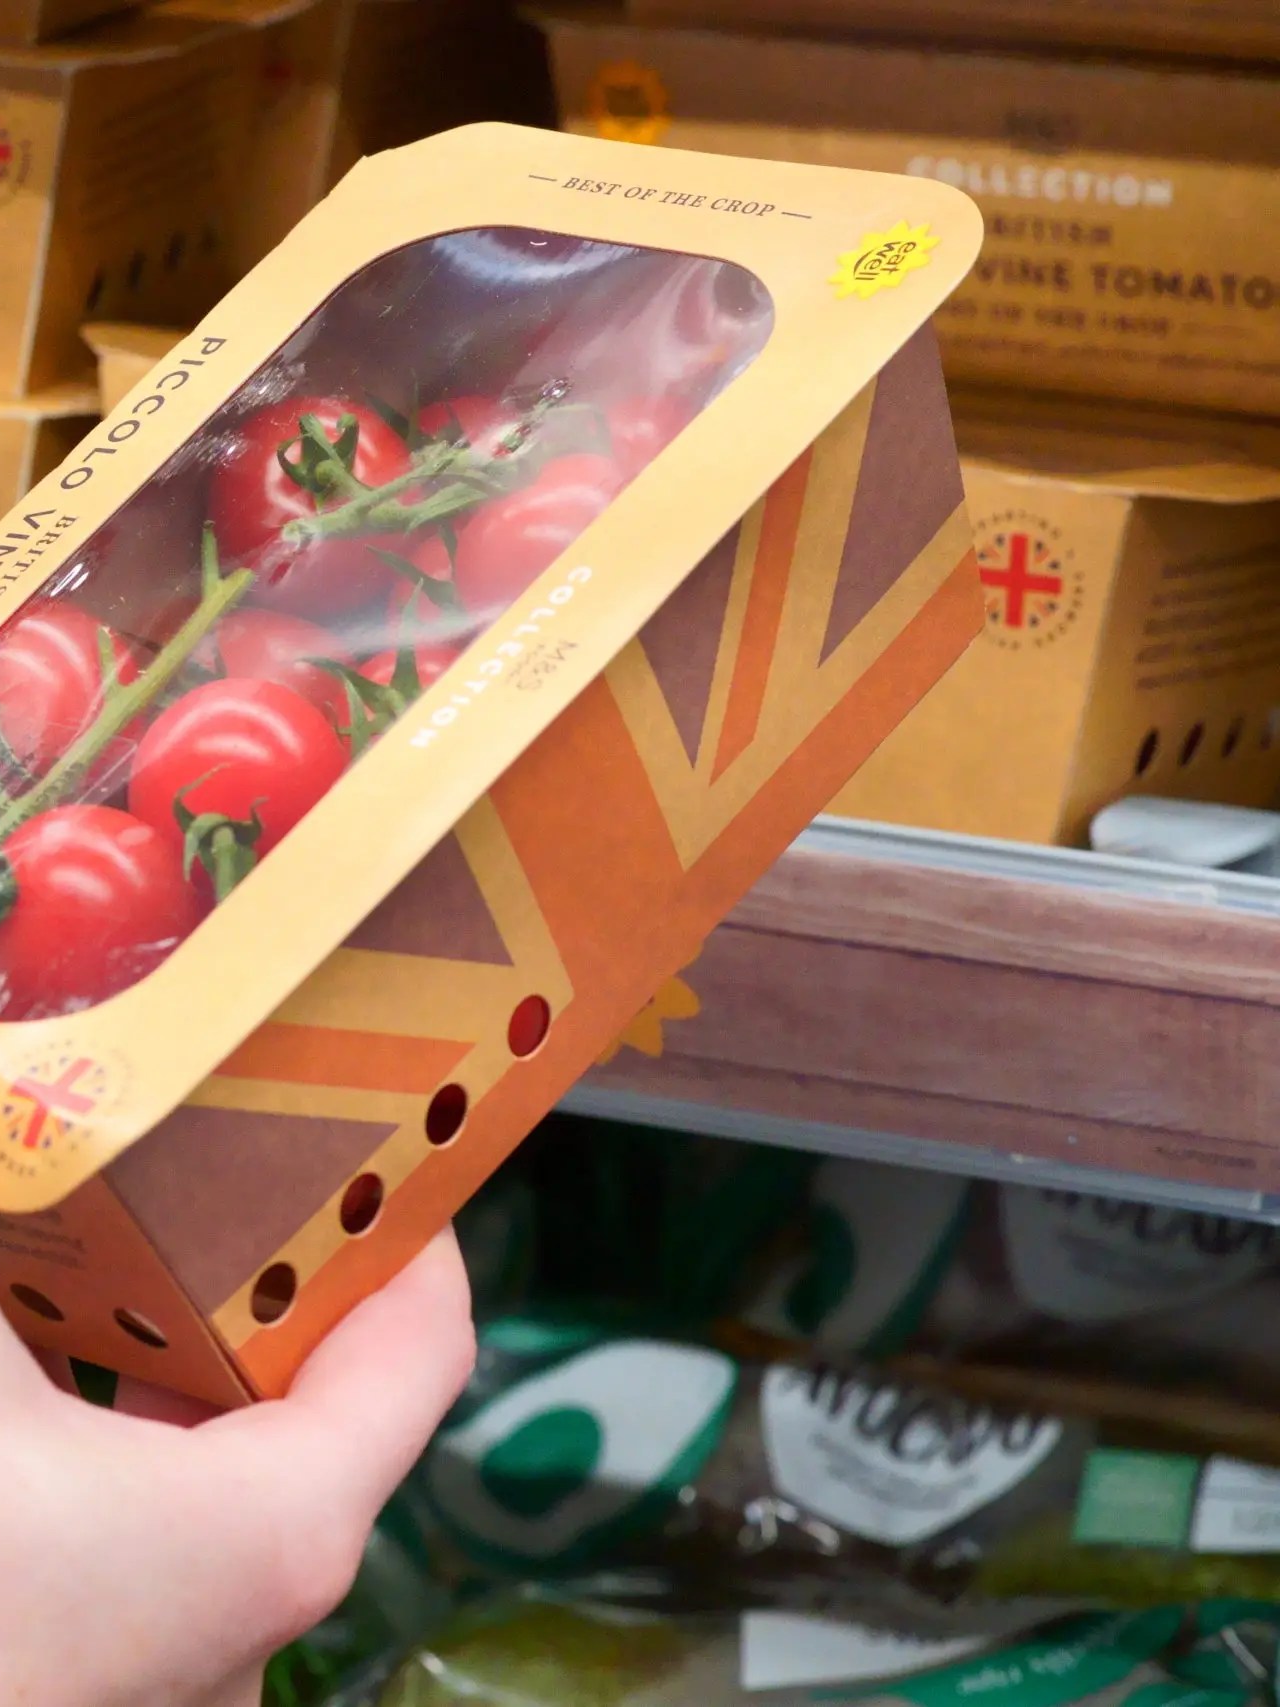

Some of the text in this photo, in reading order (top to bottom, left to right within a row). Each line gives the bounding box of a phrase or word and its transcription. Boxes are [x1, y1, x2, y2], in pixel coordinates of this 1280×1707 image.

[562, 176, 777, 218] BEST OF THE CROP
[854, 240, 902, 281] well
[879, 241, 917, 275] eat
[1089, 262, 1280, 310] TOMATO
[60, 336, 228, 491] PICCOLO
[410, 565, 593, 748] COLLECTION
